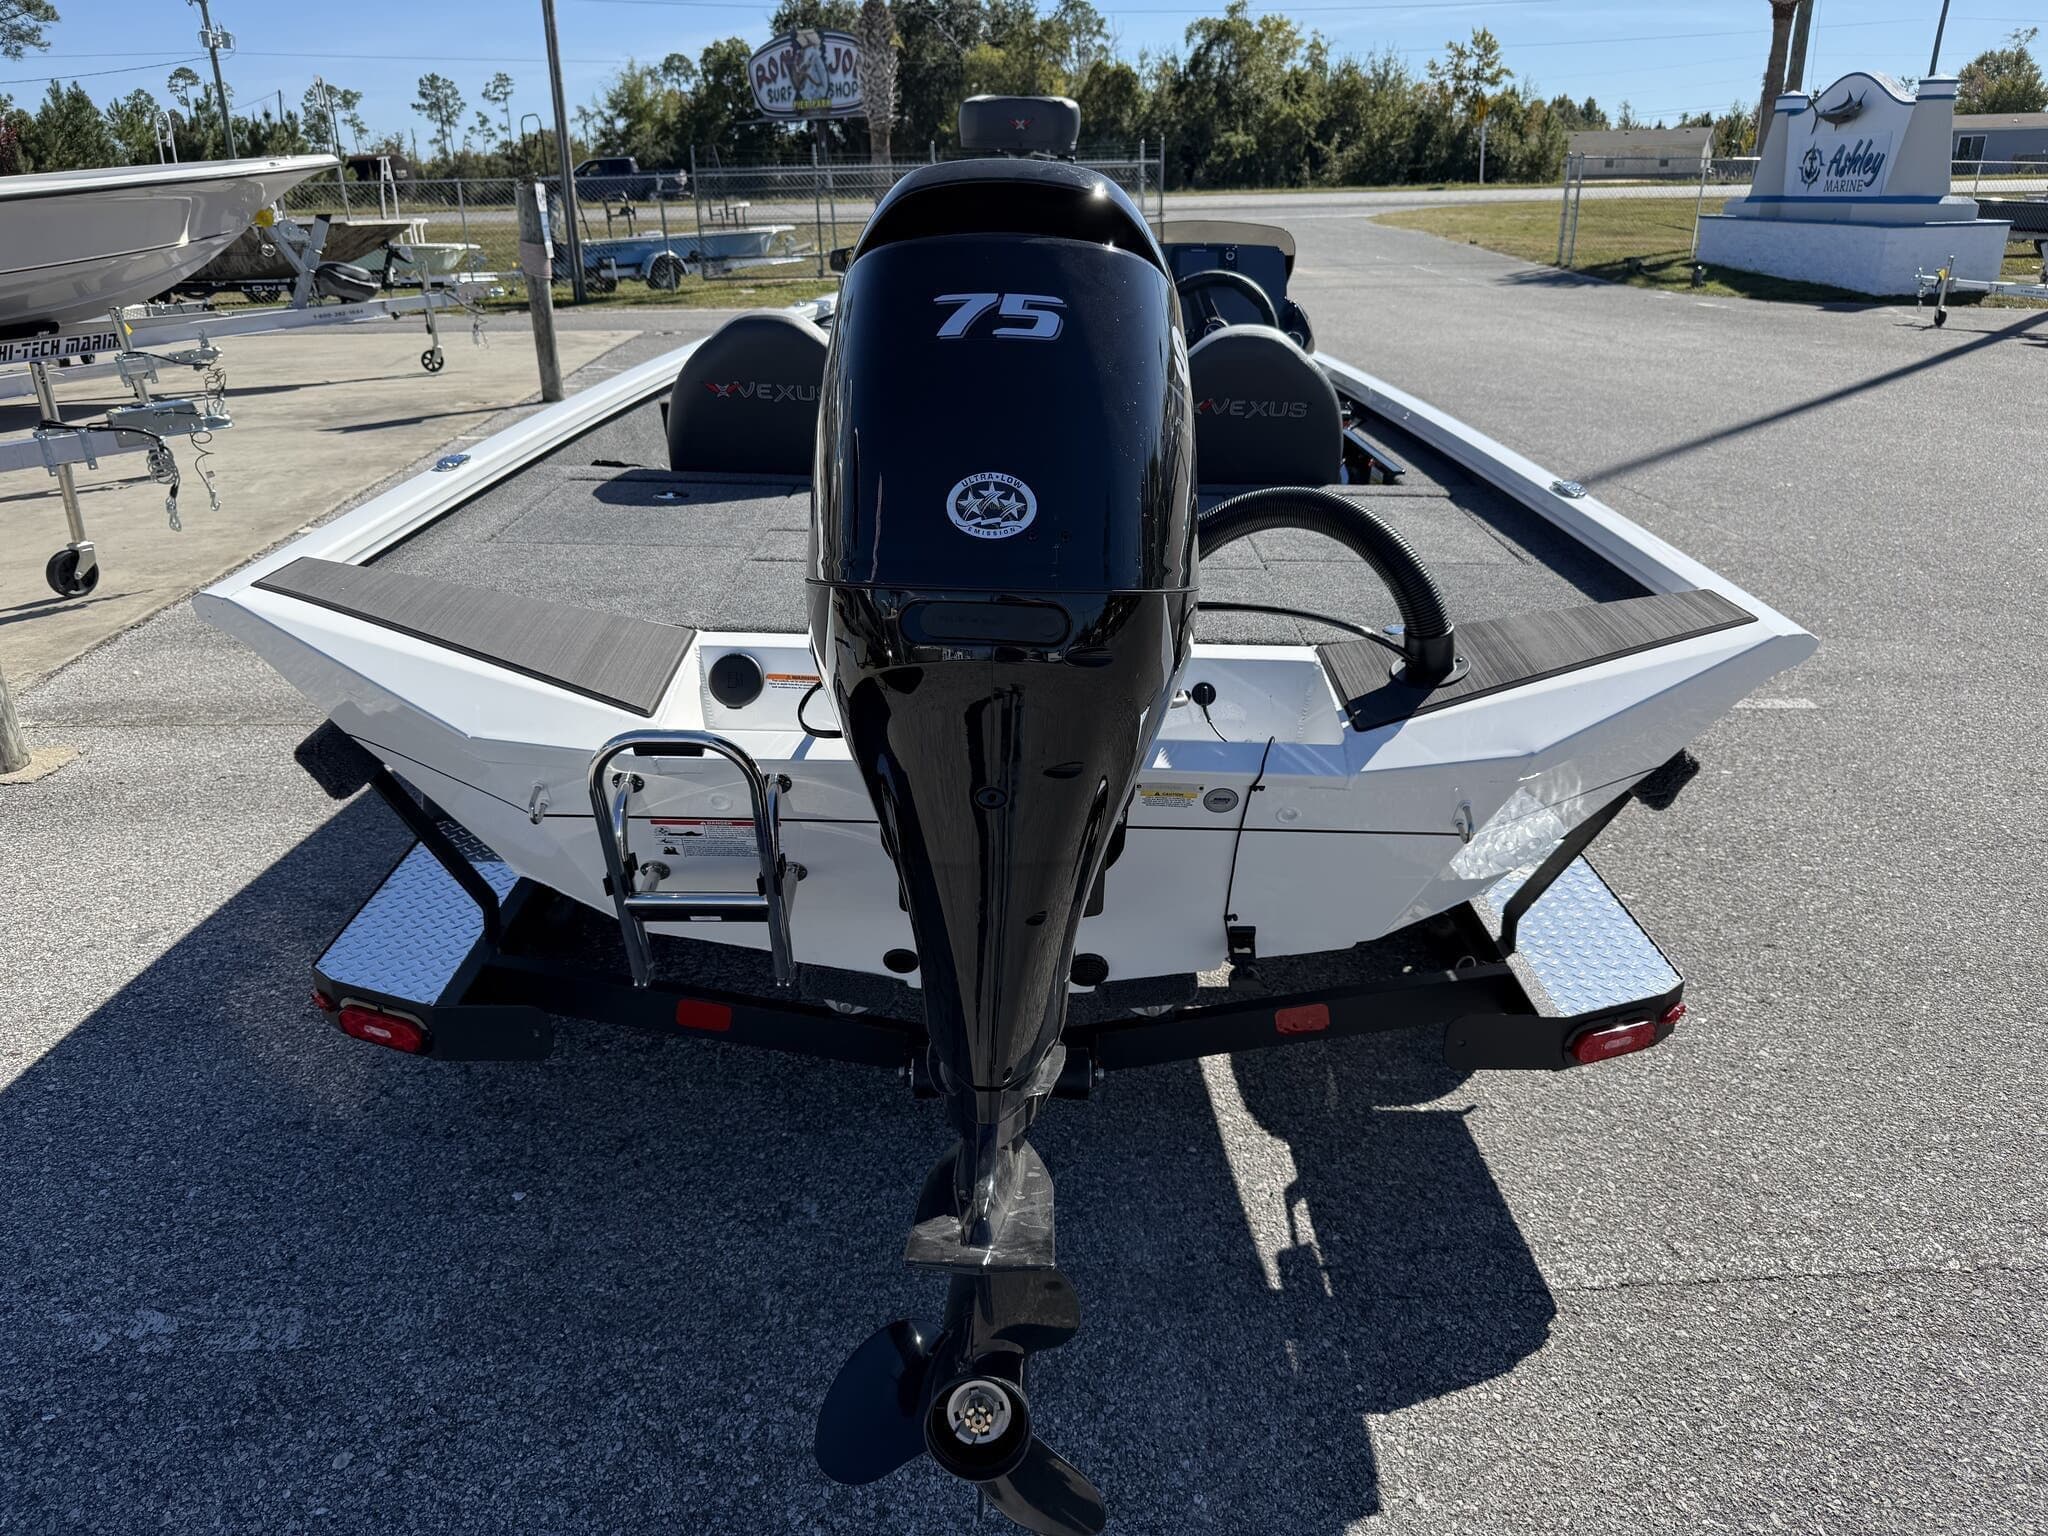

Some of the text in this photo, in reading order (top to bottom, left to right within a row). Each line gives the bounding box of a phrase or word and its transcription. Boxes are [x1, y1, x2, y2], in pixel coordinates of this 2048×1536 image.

[767, 81, 858, 104] SURF SHOP
[1827, 138, 1885, 187] Ashley
[1823, 179, 1864, 193] MARINE
[241, 284, 288, 292] LOWE
[933, 293, 1067, 341] 75
[0, 333, 121, 361] HI-TECH MARIN
[734, 381, 822, 402] VEXU
[1209, 398, 1308, 419] VEXUS
[961, 473, 1023, 489] ULTRA LOW
[967, 526, 1016, 537] EMISSION
